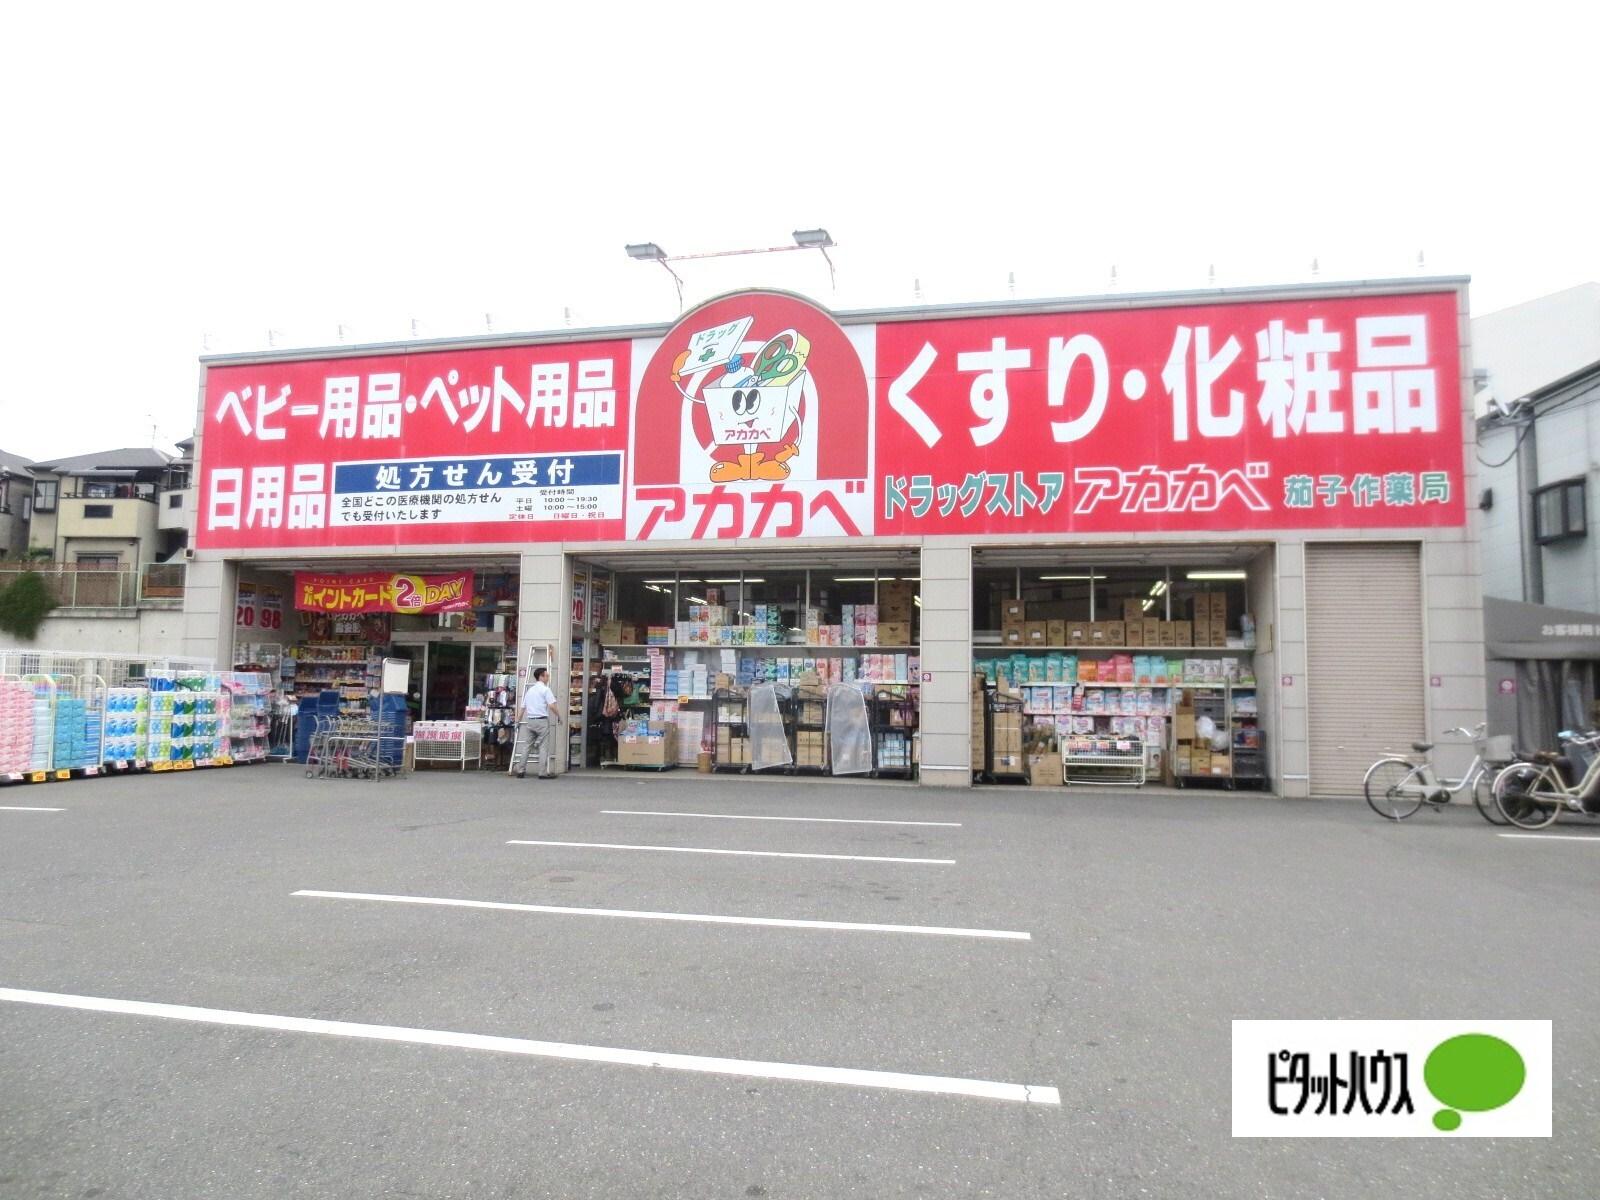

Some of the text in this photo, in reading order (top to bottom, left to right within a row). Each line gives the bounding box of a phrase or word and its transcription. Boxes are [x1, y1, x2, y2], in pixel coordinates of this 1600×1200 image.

[695, 323, 738, 346] ドラッグ
[887, 314, 1439, 449] くすり・化粧品
[215, 358, 616, 441] ベビー用品・ペット用品
[724, 428, 772, 441] アカカベ
[375, 459, 575, 490] 処方せん受付
[884, 461, 1451, 519] ドラッグストア アカカベ 茄子作薬局
[207, 463, 326, 531] 日用品
[341, 493, 502, 509] 全国どこの医療機関の処方せん
[635, 480, 865, 541] アカカベ
[341, 508, 442, 522] でも受付いたします
[303, 584, 393, 609] ポイントカード
[426, 577, 465, 605] DAY
